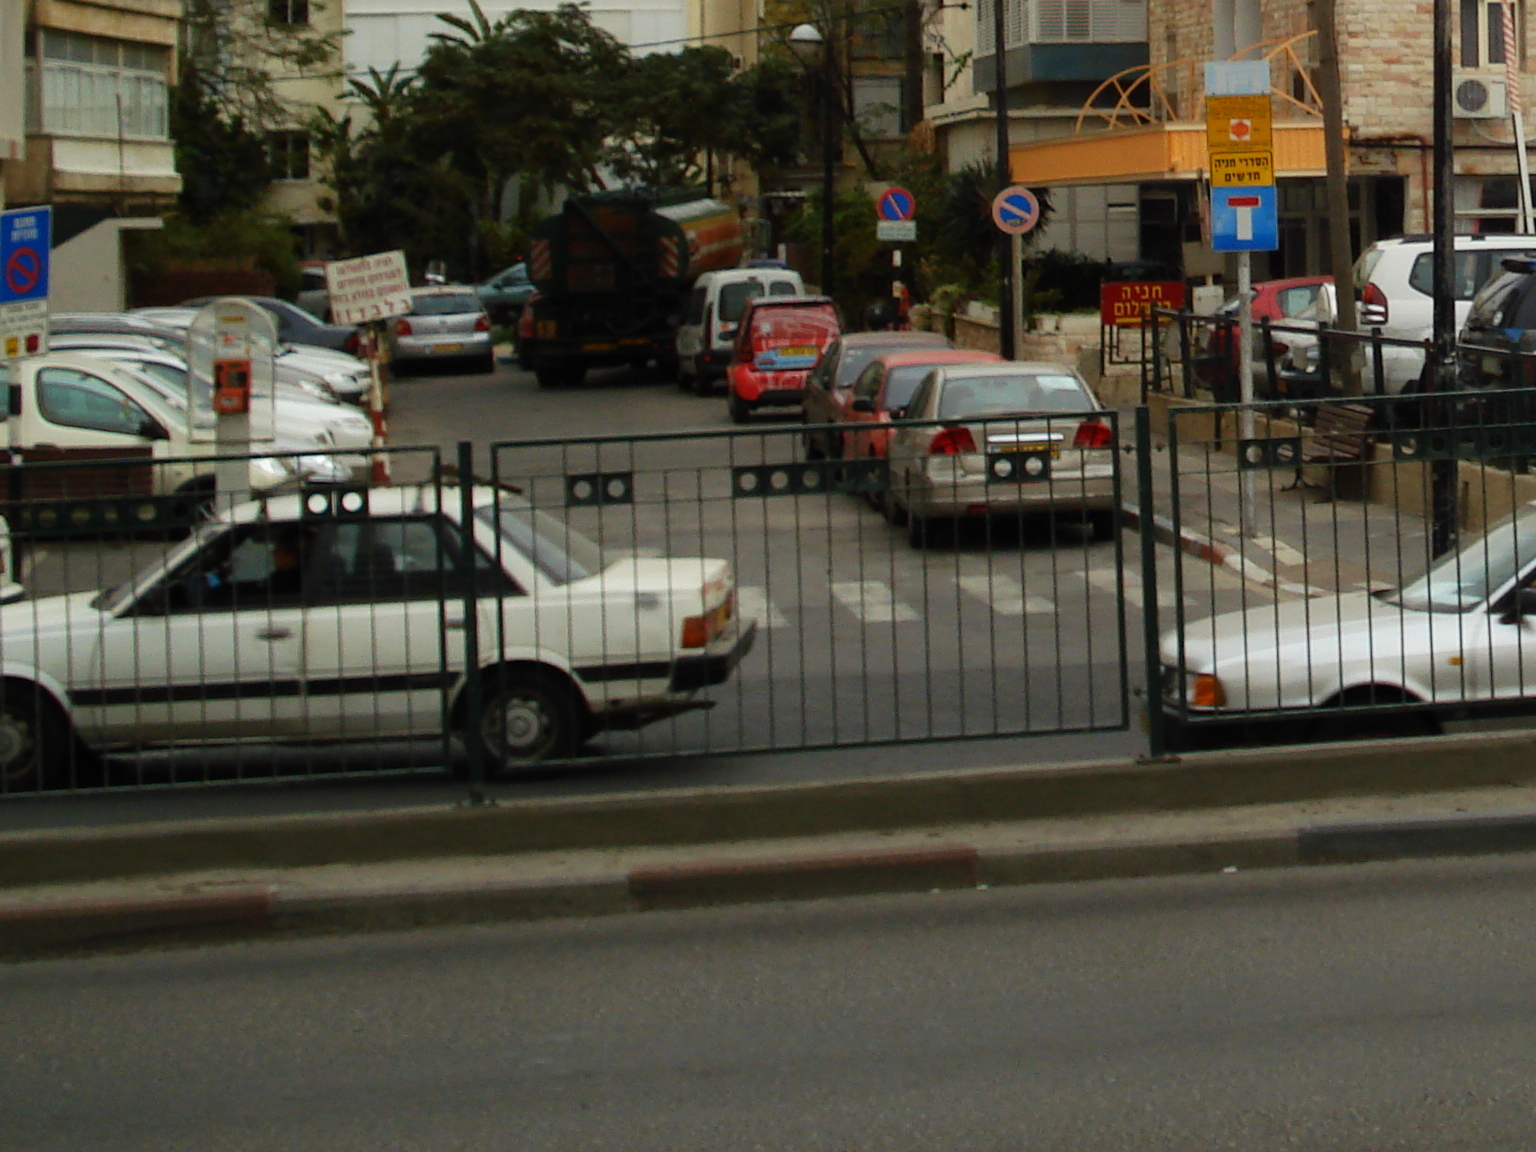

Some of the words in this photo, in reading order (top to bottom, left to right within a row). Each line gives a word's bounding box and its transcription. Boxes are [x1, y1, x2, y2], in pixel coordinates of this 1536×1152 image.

[1213, 158, 1237, 169] חניה
[1238, 156, 1269, 168] הסדרי
[1223, 172, 1261, 183] חדשים
[1121, 285, 1163, 300] חניה
